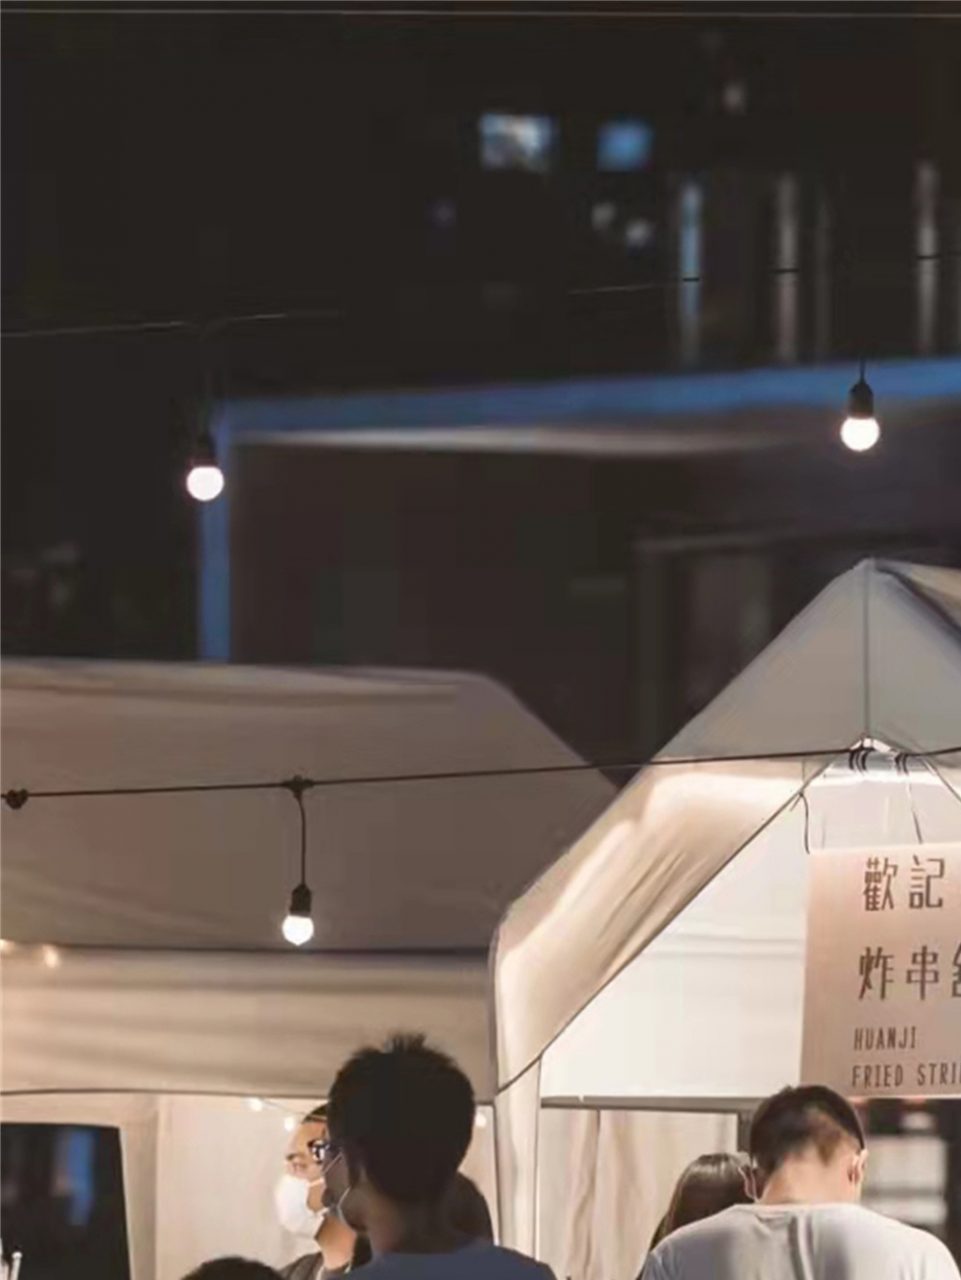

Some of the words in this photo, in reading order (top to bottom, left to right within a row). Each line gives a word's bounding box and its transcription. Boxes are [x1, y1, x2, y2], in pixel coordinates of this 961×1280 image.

[863, 854, 946, 912] 歡記
[853, 1026, 917, 1050] HUANJI
[852, 1064, 904, 1088] FRIED
